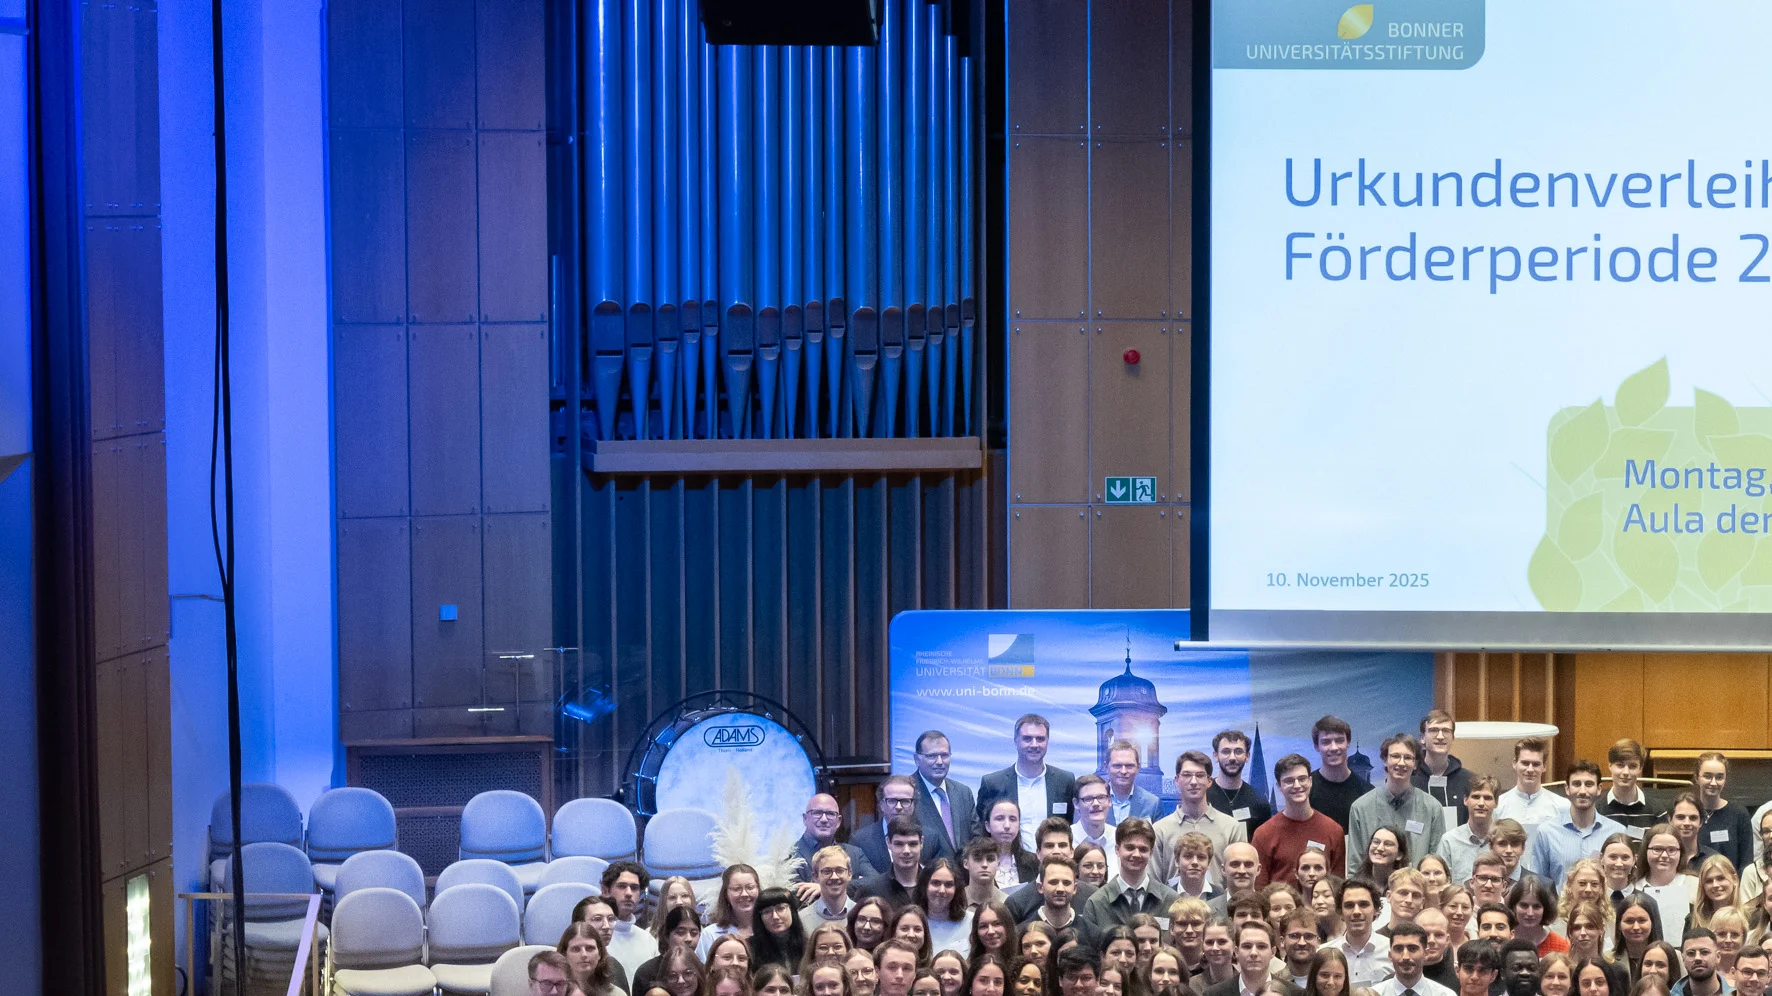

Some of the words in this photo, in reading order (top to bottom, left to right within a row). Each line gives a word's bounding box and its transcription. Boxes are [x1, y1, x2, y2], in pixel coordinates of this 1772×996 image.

[1388, 22, 1464, 38] BONNER
[1246, 41, 1464, 60] UNIVERSITÄTSSTIFTUNG
[1285, 231, 1718, 295] Förderperiode
[1622, 502, 1704, 534] Aula
[1266, 572, 1291, 588] 10.
[1296, 572, 1384, 588] November
[1388, 572, 1430, 588] 2025
[915, 665, 986, 677] UNIVERSITÄT
[916, 685, 1036, 697] www.uni-bonn.de
[711, 728, 760, 745] ADAMS
